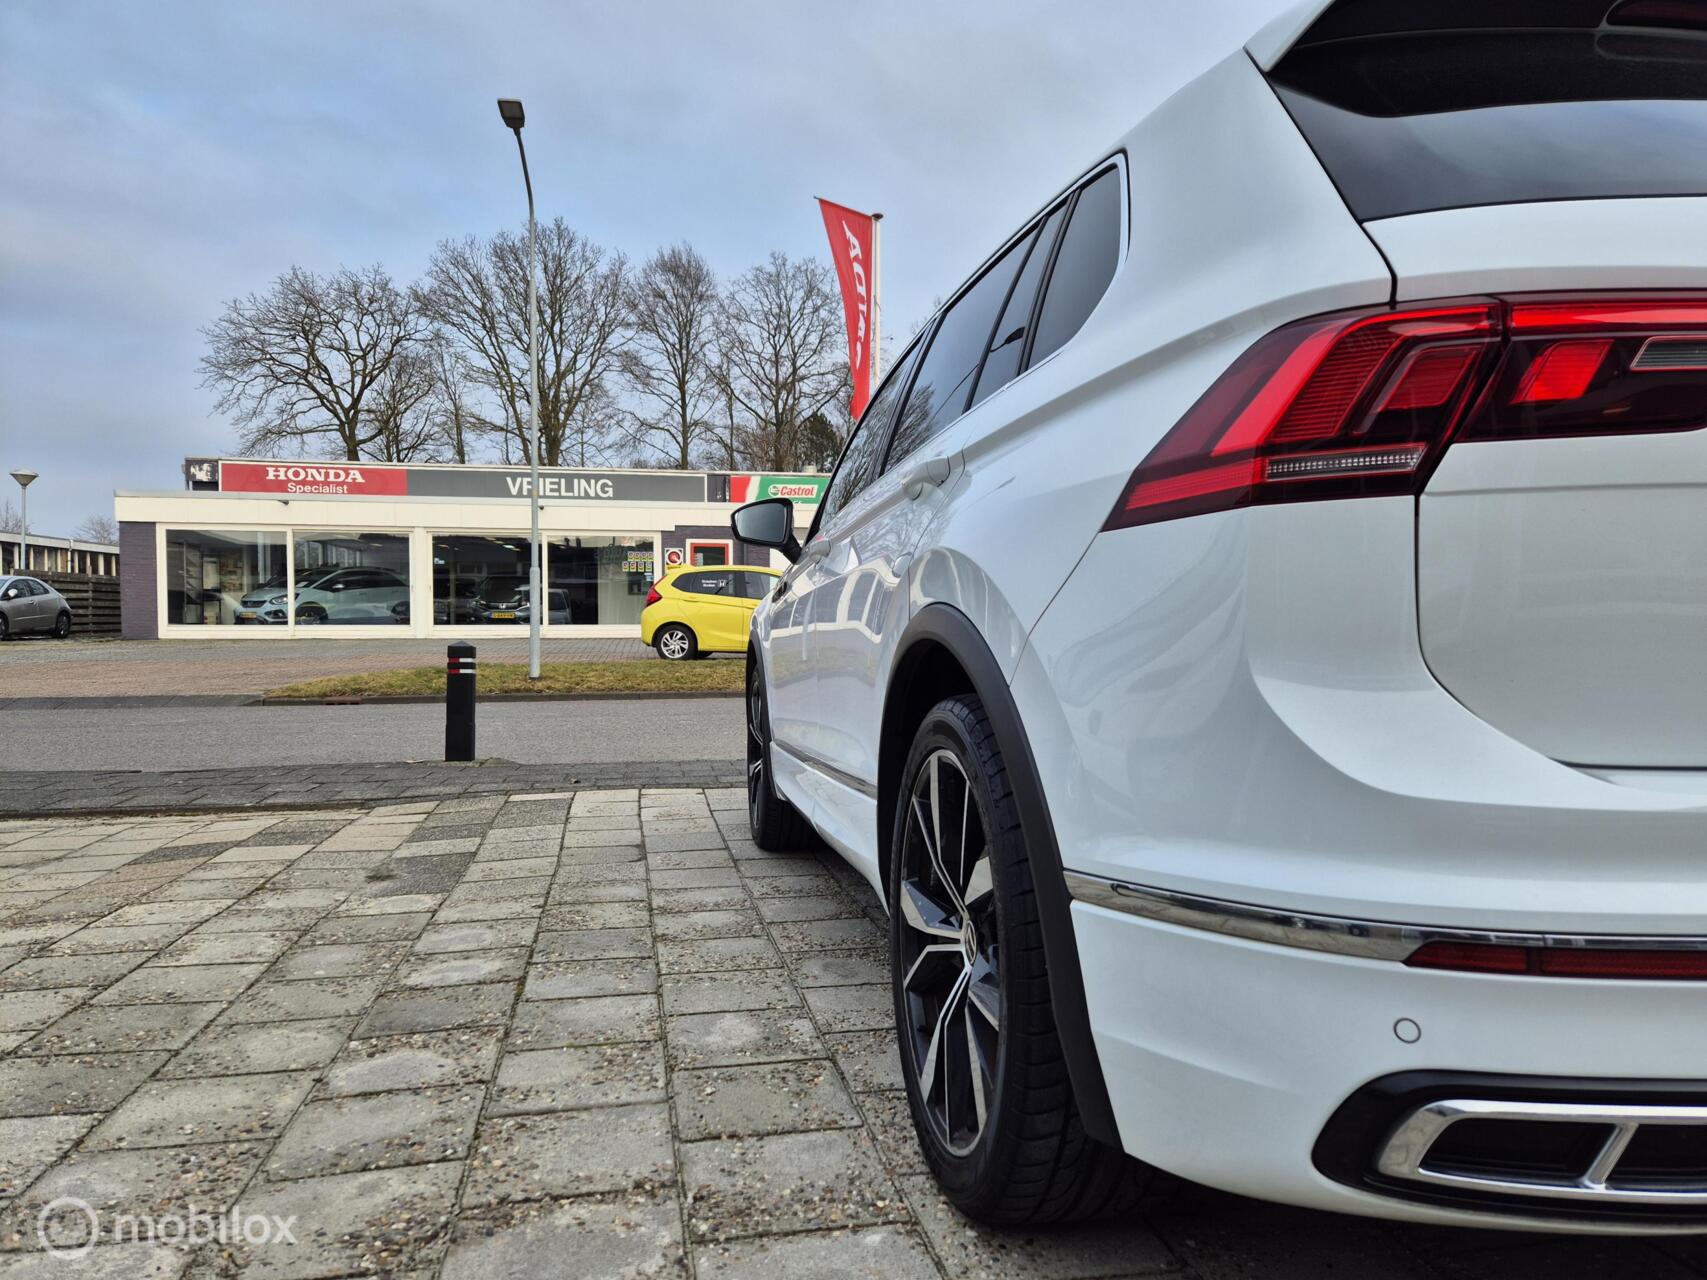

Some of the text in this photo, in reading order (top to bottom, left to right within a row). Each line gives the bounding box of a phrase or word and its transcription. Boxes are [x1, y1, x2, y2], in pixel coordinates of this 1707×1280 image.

[265, 467, 365, 483] HONDA
[287, 482, 348, 494] Specialist
[780, 485, 815, 497] Castrol
